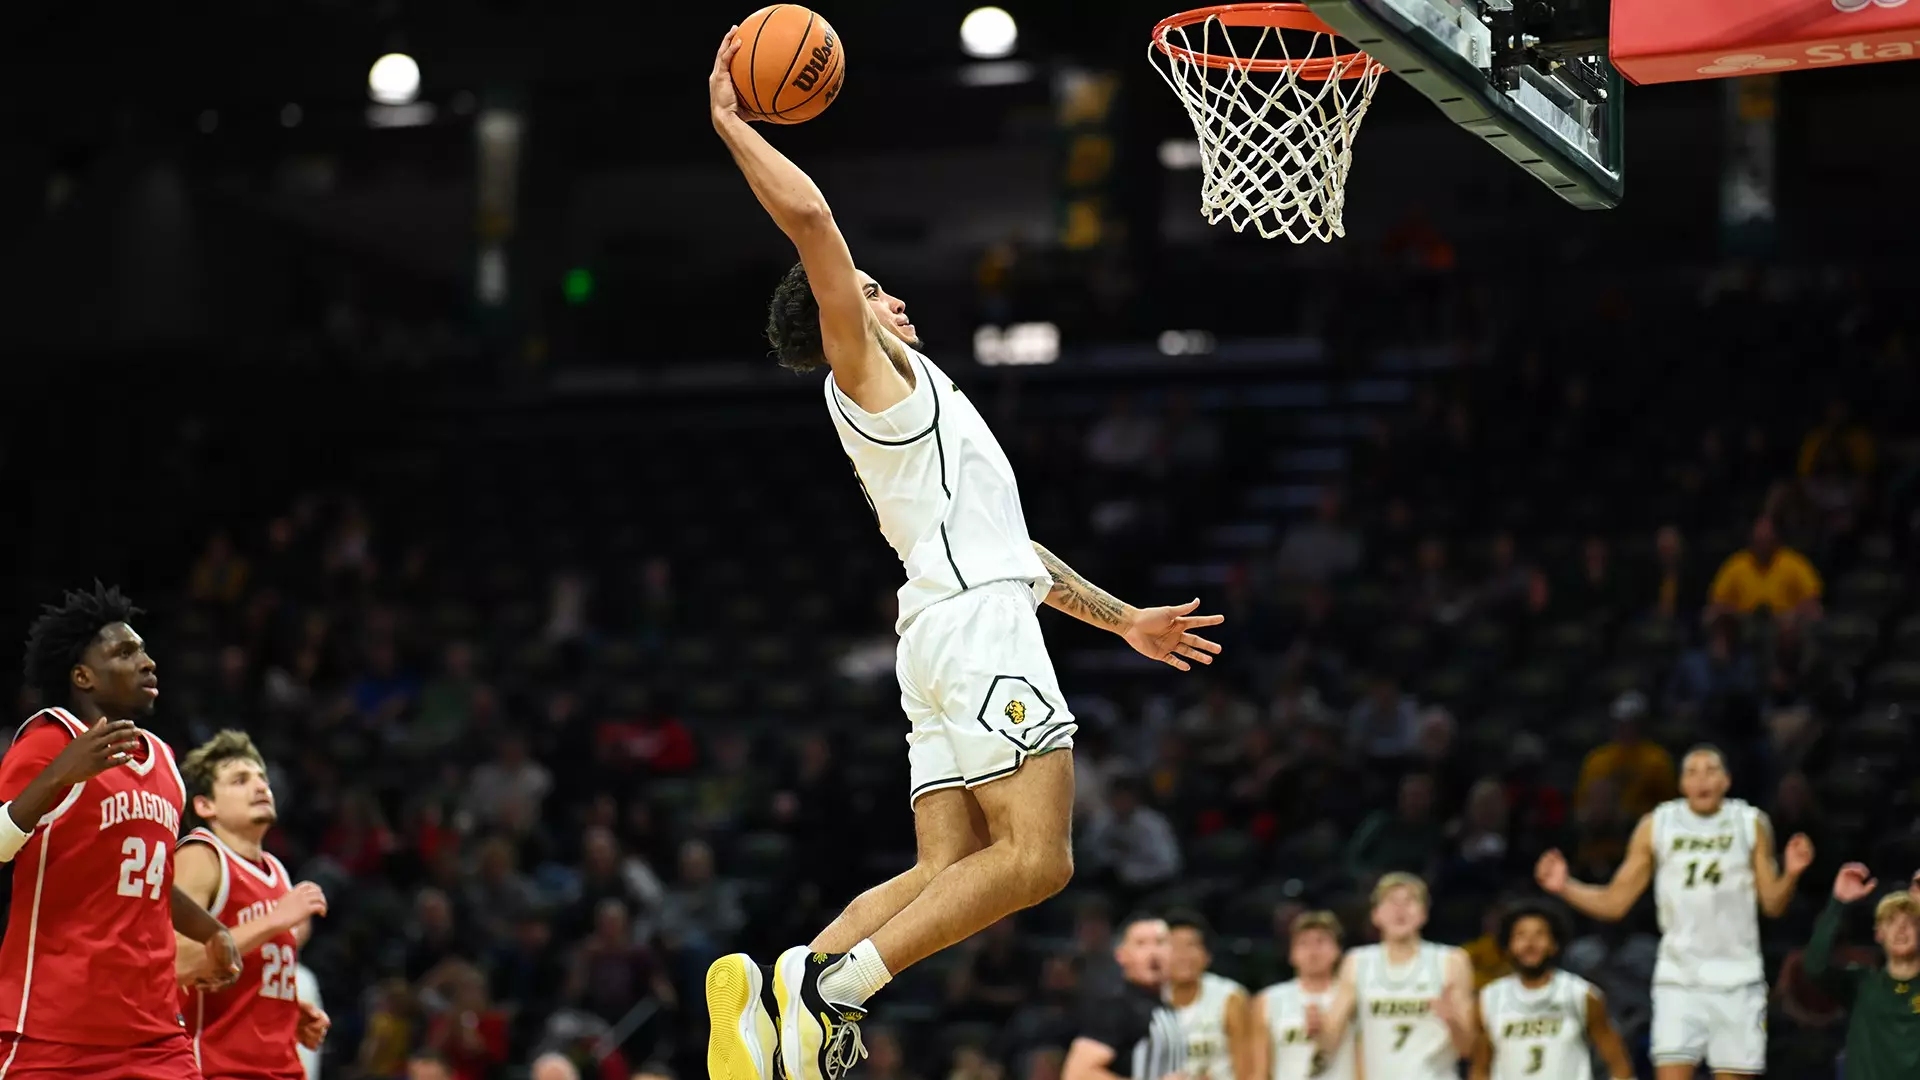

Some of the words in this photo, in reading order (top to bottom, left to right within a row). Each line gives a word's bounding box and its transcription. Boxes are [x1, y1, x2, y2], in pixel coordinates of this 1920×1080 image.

[792, 30, 835, 92] Wilson
[1805, 41, 1920, 64] Sta
[99, 789, 180, 841] DRAGONS
[117, 836, 167, 900] 24
[1684, 861, 1722, 889] 14
[258, 943, 296, 1001] 22
[1393, 1023, 1412, 1053] 7
[1522, 1046, 1545, 1076] 3
